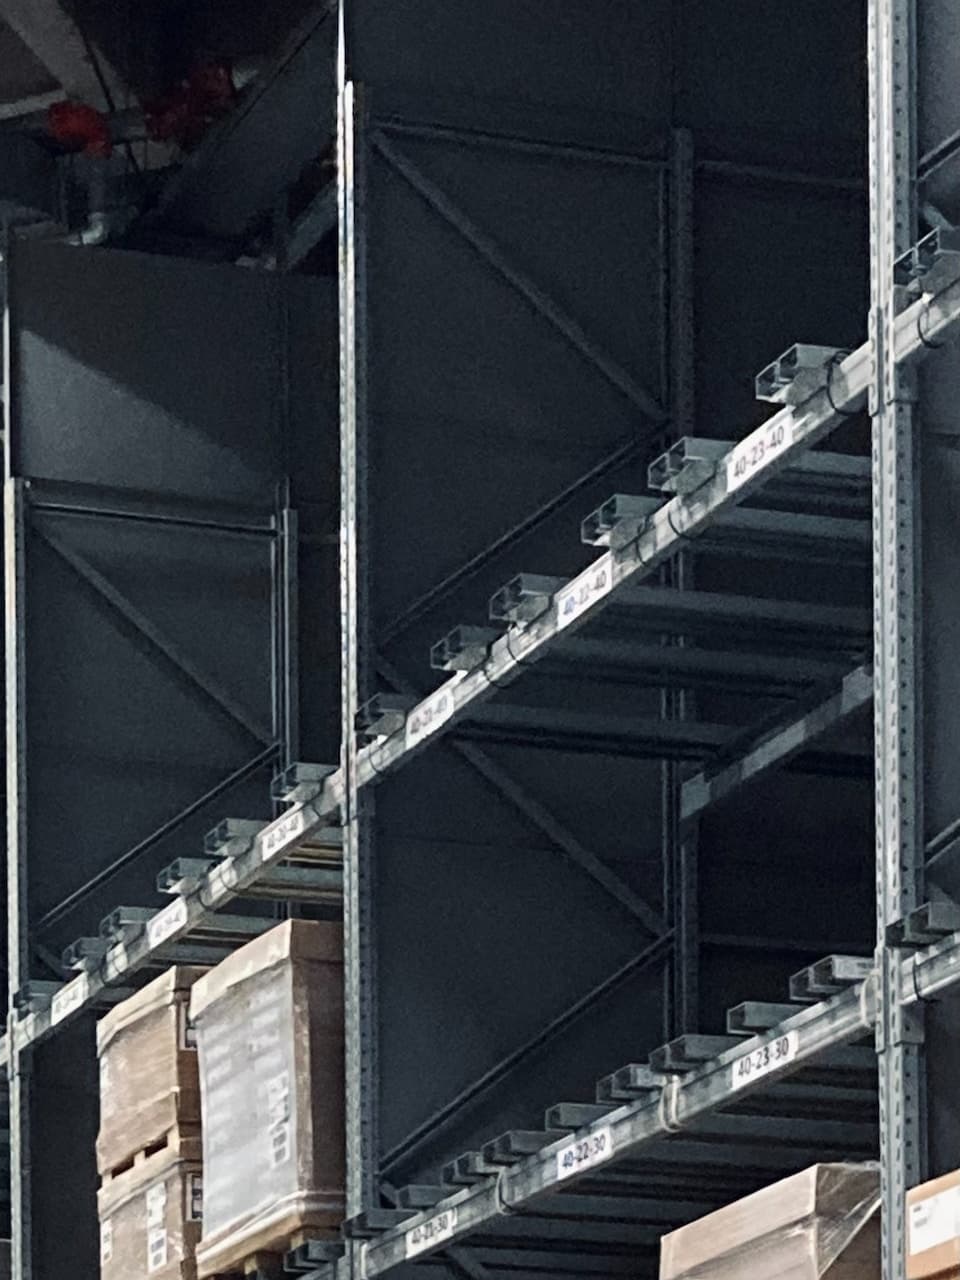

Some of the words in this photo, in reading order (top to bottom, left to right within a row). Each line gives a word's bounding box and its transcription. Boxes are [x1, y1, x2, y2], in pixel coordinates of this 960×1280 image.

[733, 425, 785, 478] 40-23-40
[738, 1037, 790, 1078] 40-23-30
[563, 1134, 606, 1169] 40-22-30
